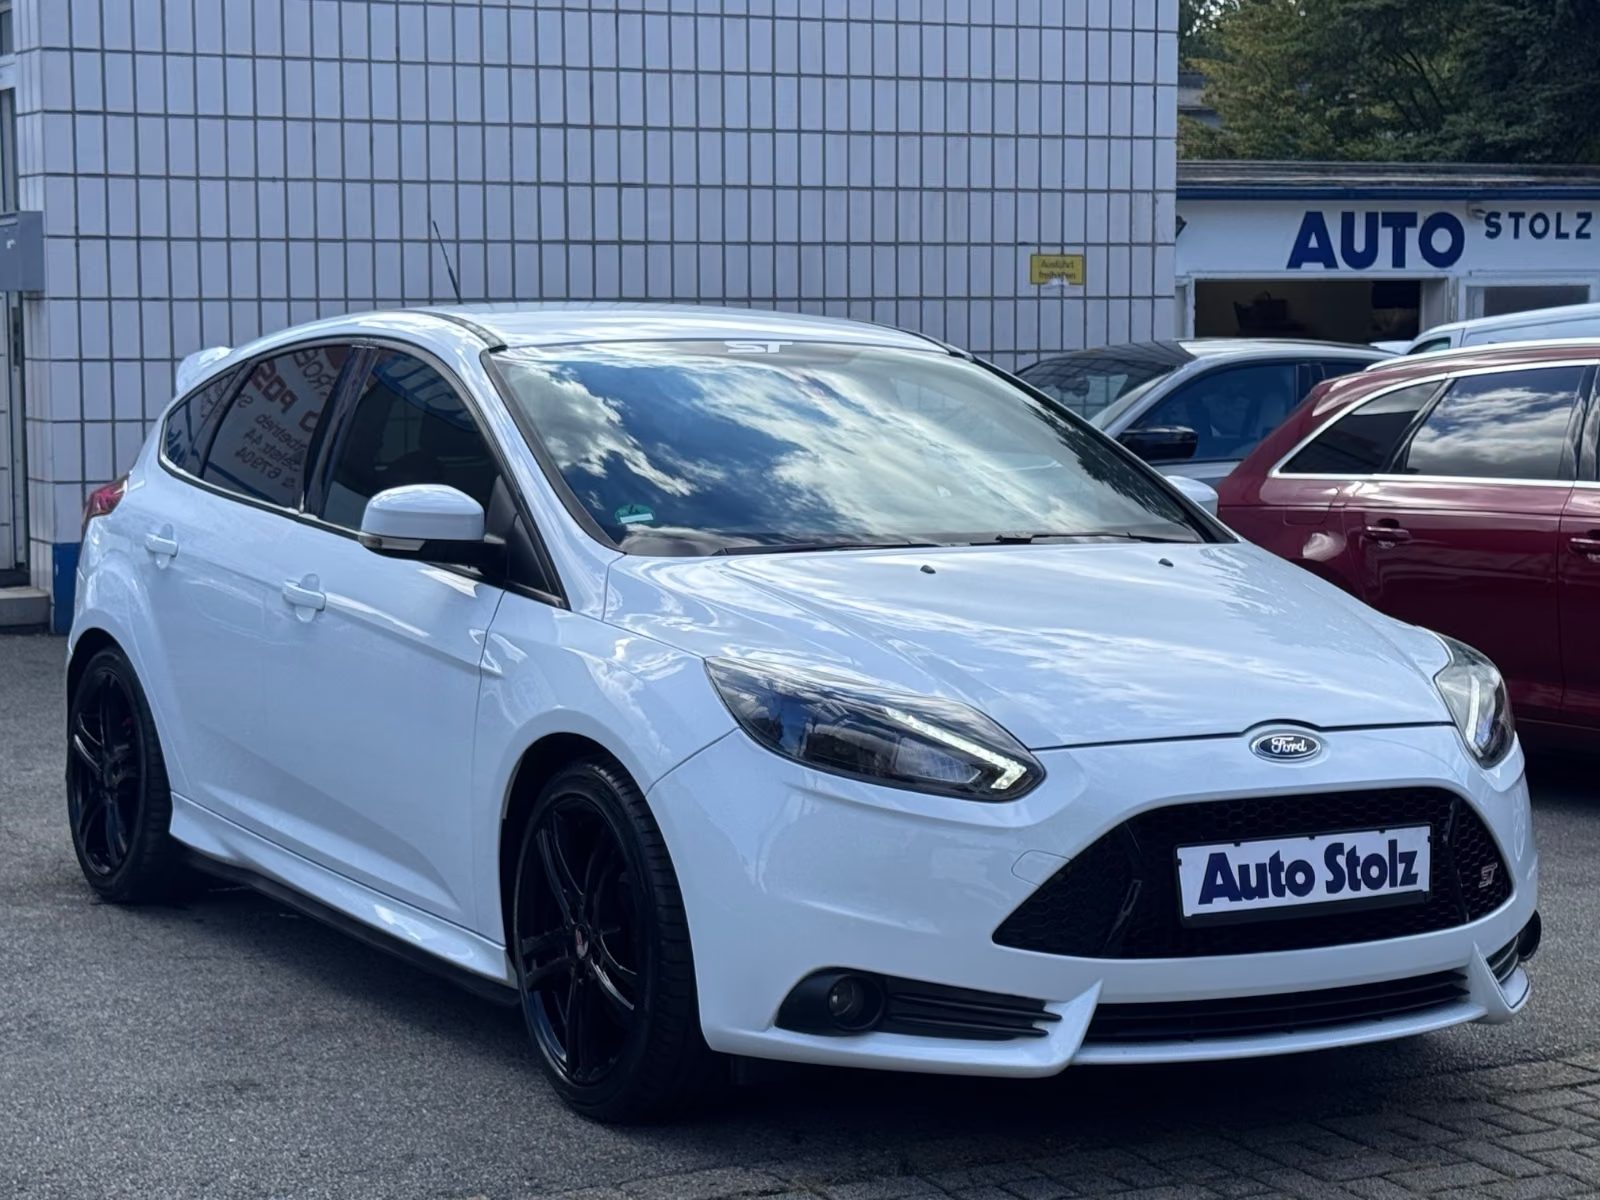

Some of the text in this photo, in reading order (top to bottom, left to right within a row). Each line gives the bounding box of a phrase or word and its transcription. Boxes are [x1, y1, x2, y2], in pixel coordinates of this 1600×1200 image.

[1286, 211, 1593, 269] AUTO STOLZ
[724, 341, 793, 354] ST
[1271, 736, 1308, 753] Ford
[1198, 839, 1419, 905] Auto Stolz
